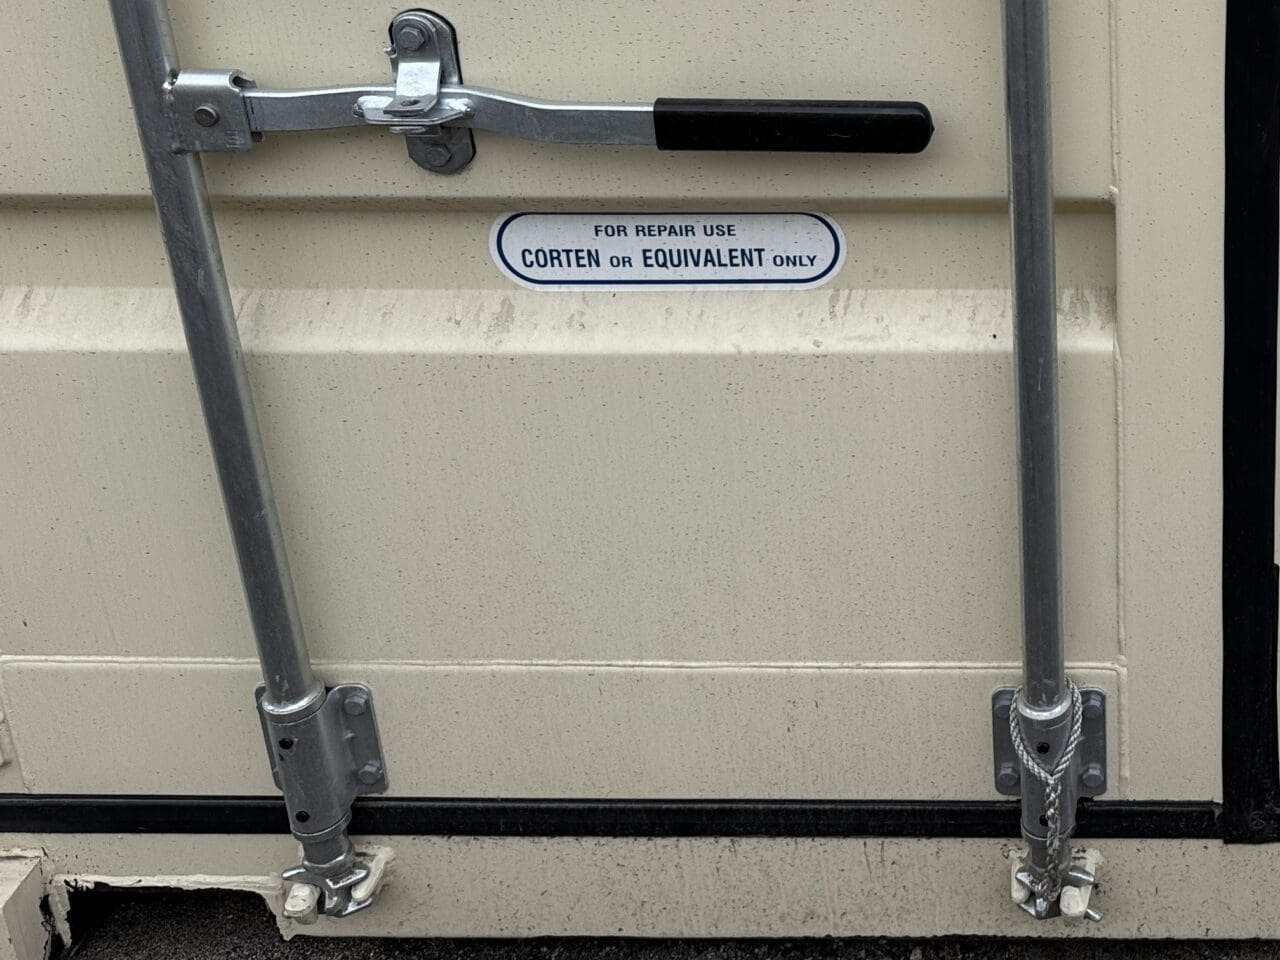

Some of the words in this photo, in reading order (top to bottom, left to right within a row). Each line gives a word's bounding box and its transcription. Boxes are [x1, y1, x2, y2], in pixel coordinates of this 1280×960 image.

[593, 224, 628, 238] FOR
[634, 224, 697, 238] REPAIR
[702, 224, 737, 238] USE
[521, 248, 601, 269] CORTEN
[609, 255, 633, 269] OR
[641, 247, 766, 270] EQUIVALENT
[772, 254, 818, 268] ONLY
